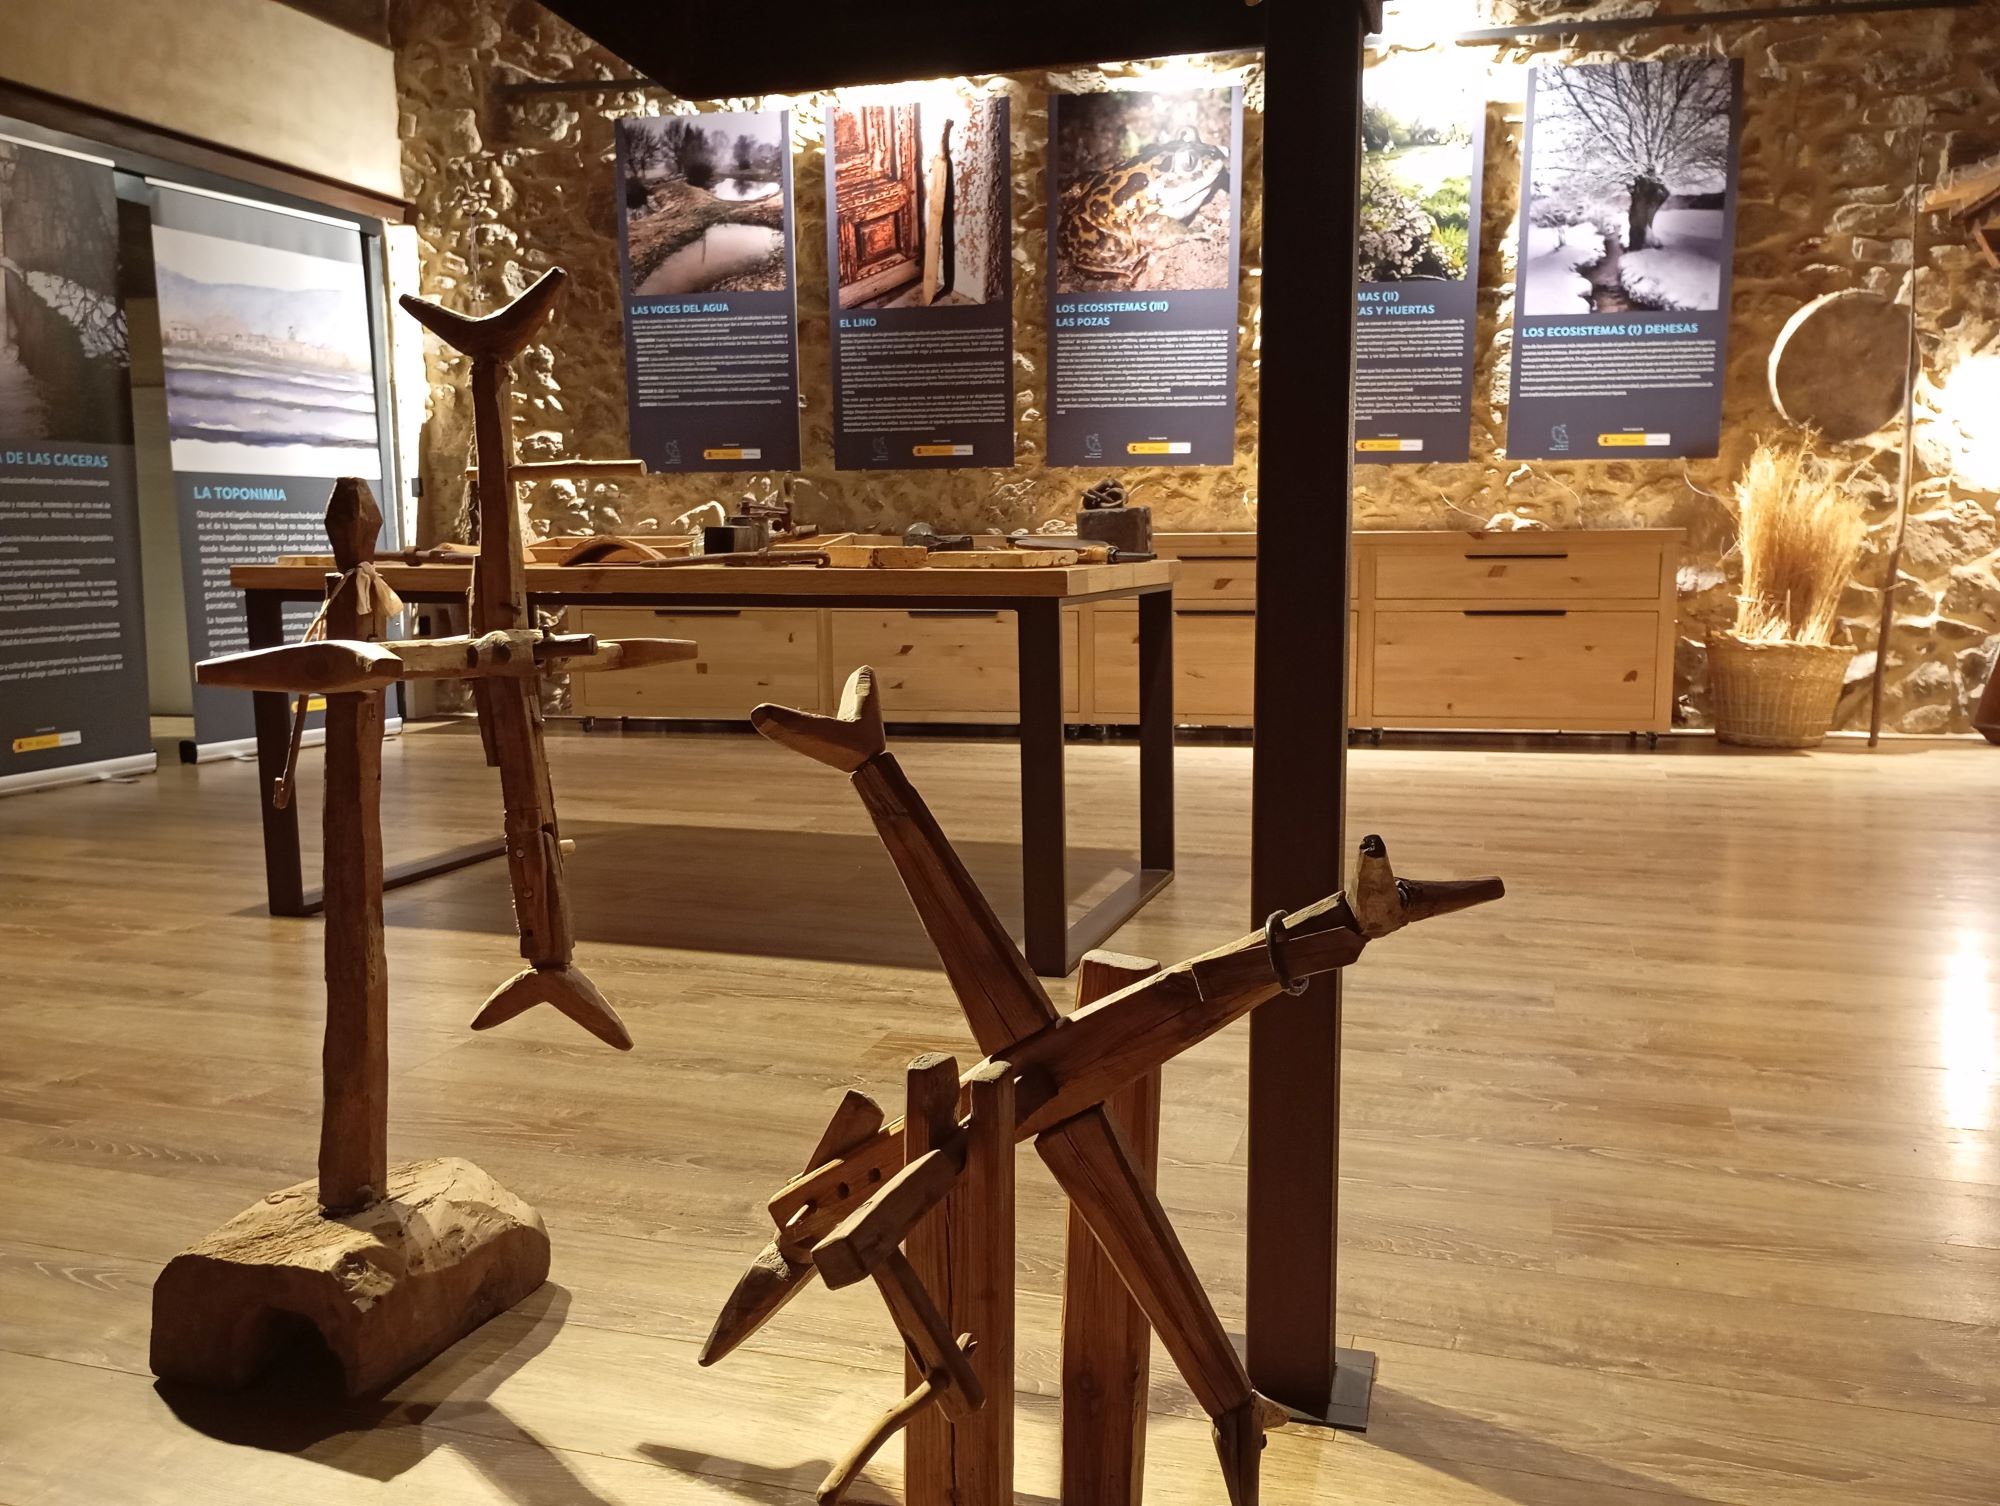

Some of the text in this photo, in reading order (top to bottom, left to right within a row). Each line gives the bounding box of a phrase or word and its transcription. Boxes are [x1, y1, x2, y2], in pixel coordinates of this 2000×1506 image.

[1382, 291, 1399, 302] (II)
[631, 303, 729, 315] LAS VOCES DEL AGUA
[1056, 301, 1169, 314] LOS ECOSISTEMAS (III)
[1357, 304, 1436, 315] AS Y HUERTAS
[839, 318, 877, 328] EL LINO
[1056, 317, 1110, 327] LAS POZAS
[1522, 327, 1545, 338] LOS
[1547, 325, 1626, 337] ECOSISTEMAS
[1644, 323, 1699, 335] DEHESAS
[6, 452, 24, 465] DE
[27, 452, 51, 466] LAS
[53, 453, 109, 468] CACERAS
[194, 486, 287, 501] LA TOPONIMIA
